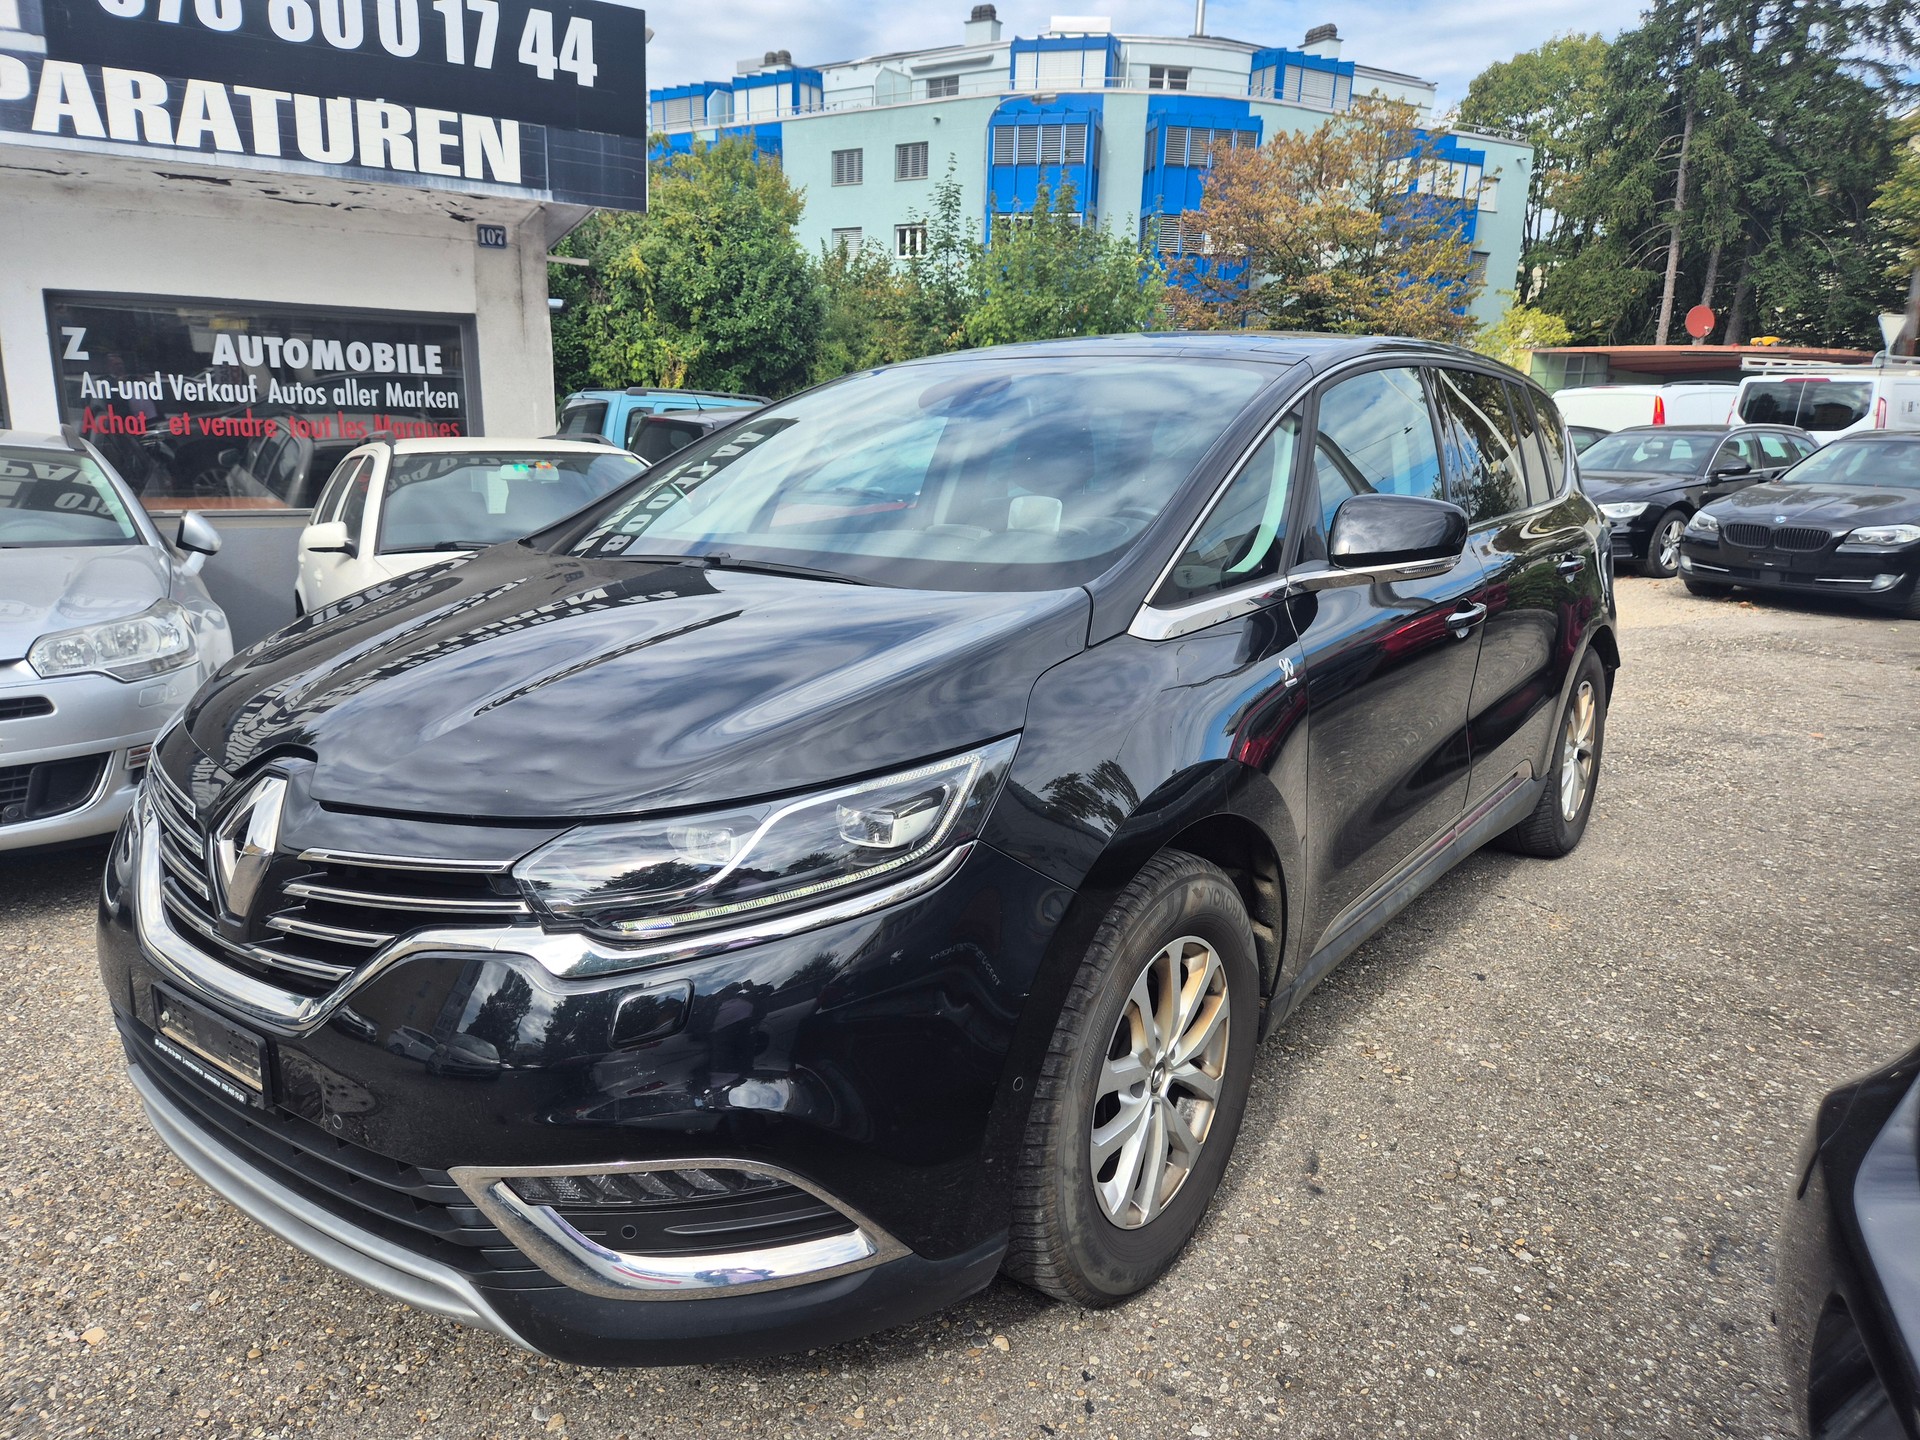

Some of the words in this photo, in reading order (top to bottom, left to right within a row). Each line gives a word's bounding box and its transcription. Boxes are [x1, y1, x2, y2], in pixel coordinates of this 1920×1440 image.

[433, 0, 499, 69] 17
[518, 8, 598, 87] 44
[480, 218, 503, 245] 107
[61, 327, 89, 360] Z
[212, 334, 443, 375] AUTOMOBILE
[81, 372, 163, 401] An-und
[170, 375, 258, 404] Verkauf
[268, 380, 327, 406] Autos
[333, 378, 379, 407] aller
[386, 382, 459, 409] Marken
[170, 412, 191, 436] et
[198, 410, 277, 439] vendre
[289, 415, 331, 439] tout
[338, 412, 367, 438] les
